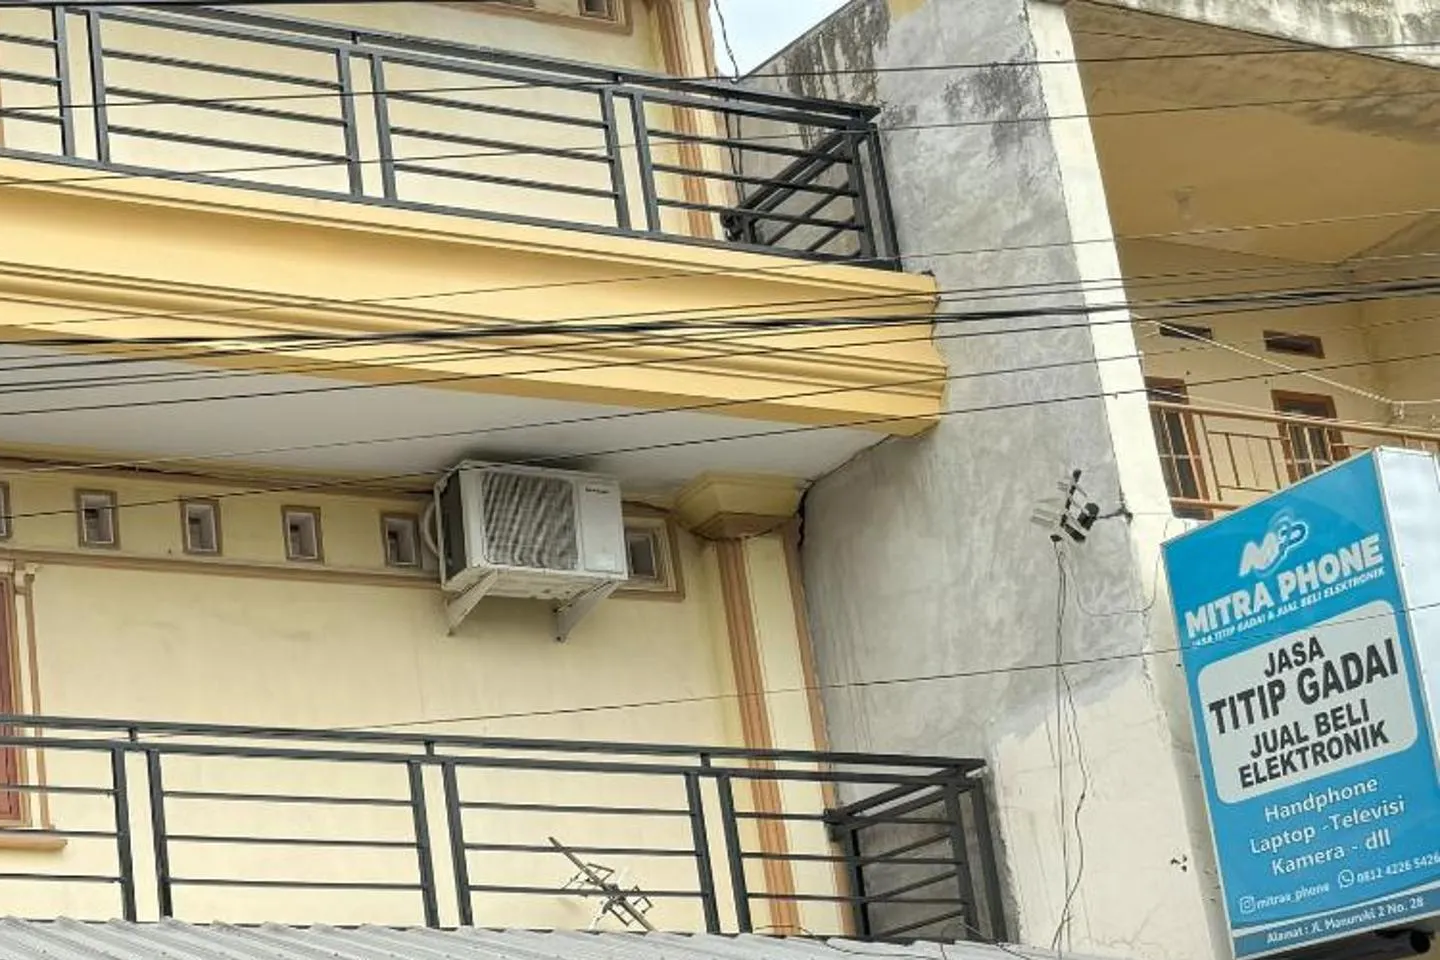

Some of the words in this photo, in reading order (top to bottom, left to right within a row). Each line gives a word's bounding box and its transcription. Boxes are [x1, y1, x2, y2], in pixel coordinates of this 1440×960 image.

[1184, 581, 1275, 638] MITRA
[1277, 533, 1385, 601] PHONE
[1263, 636, 1326, 678] JASA
[1208, 663, 1287, 734] TITIP
[1295, 638, 1400, 706] GADAI
[1237, 719, 1391, 790] ELEKTRONIK
[1249, 715, 1311, 759] JUAL
[1314, 698, 1371, 739] BELI
[1263, 775, 1379, 822] Handphone
[1249, 822, 1317, 856] Laptop
[1271, 843, 1345, 877] Kamera
[1364, 829, 1392, 852] dll
